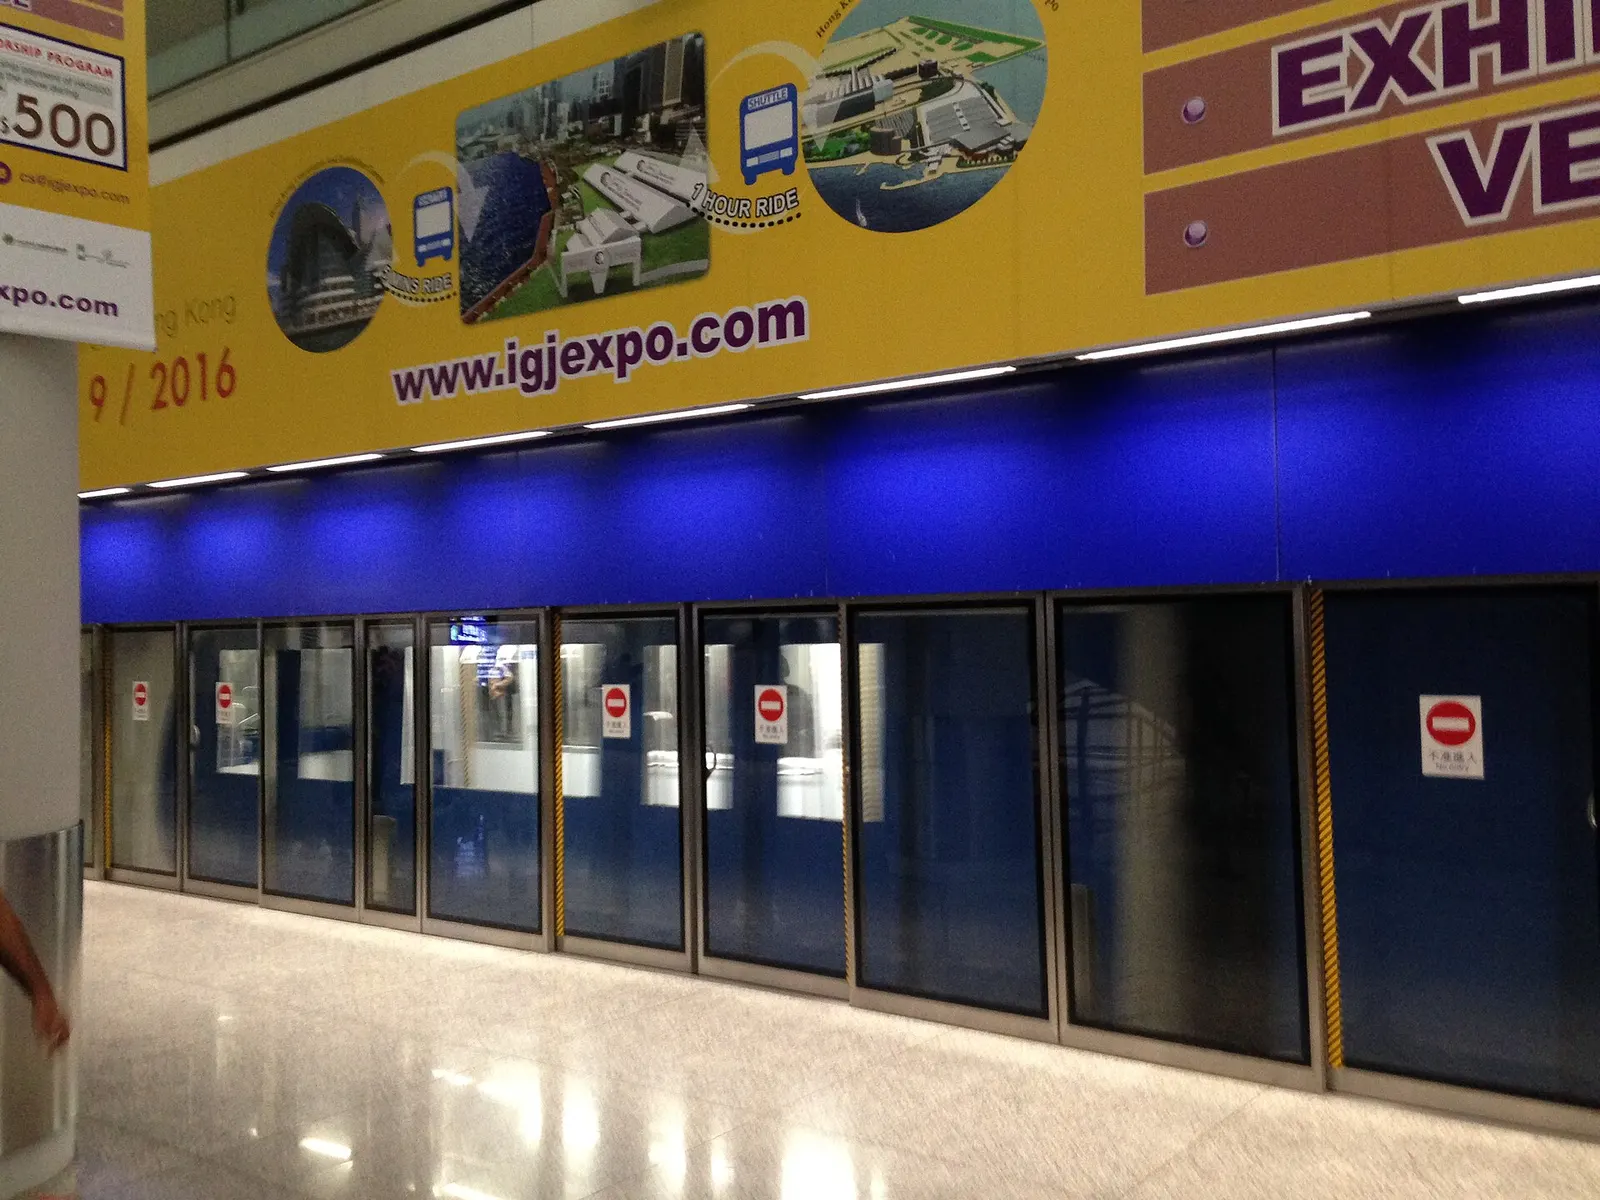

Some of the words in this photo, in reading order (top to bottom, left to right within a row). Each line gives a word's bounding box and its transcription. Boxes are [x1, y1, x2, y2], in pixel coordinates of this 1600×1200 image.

[47, 50, 114, 79] PROGRAM
[1272, 0, 1600, 136] EXHI
[749, 88, 787, 109] SHUTTLE
[701, 188, 751, 218] HOUR
[755, 187, 800, 218] RIDE
[393, 296, 808, 405] www.igjexpo.com
[150, 346, 236, 410] 2016
